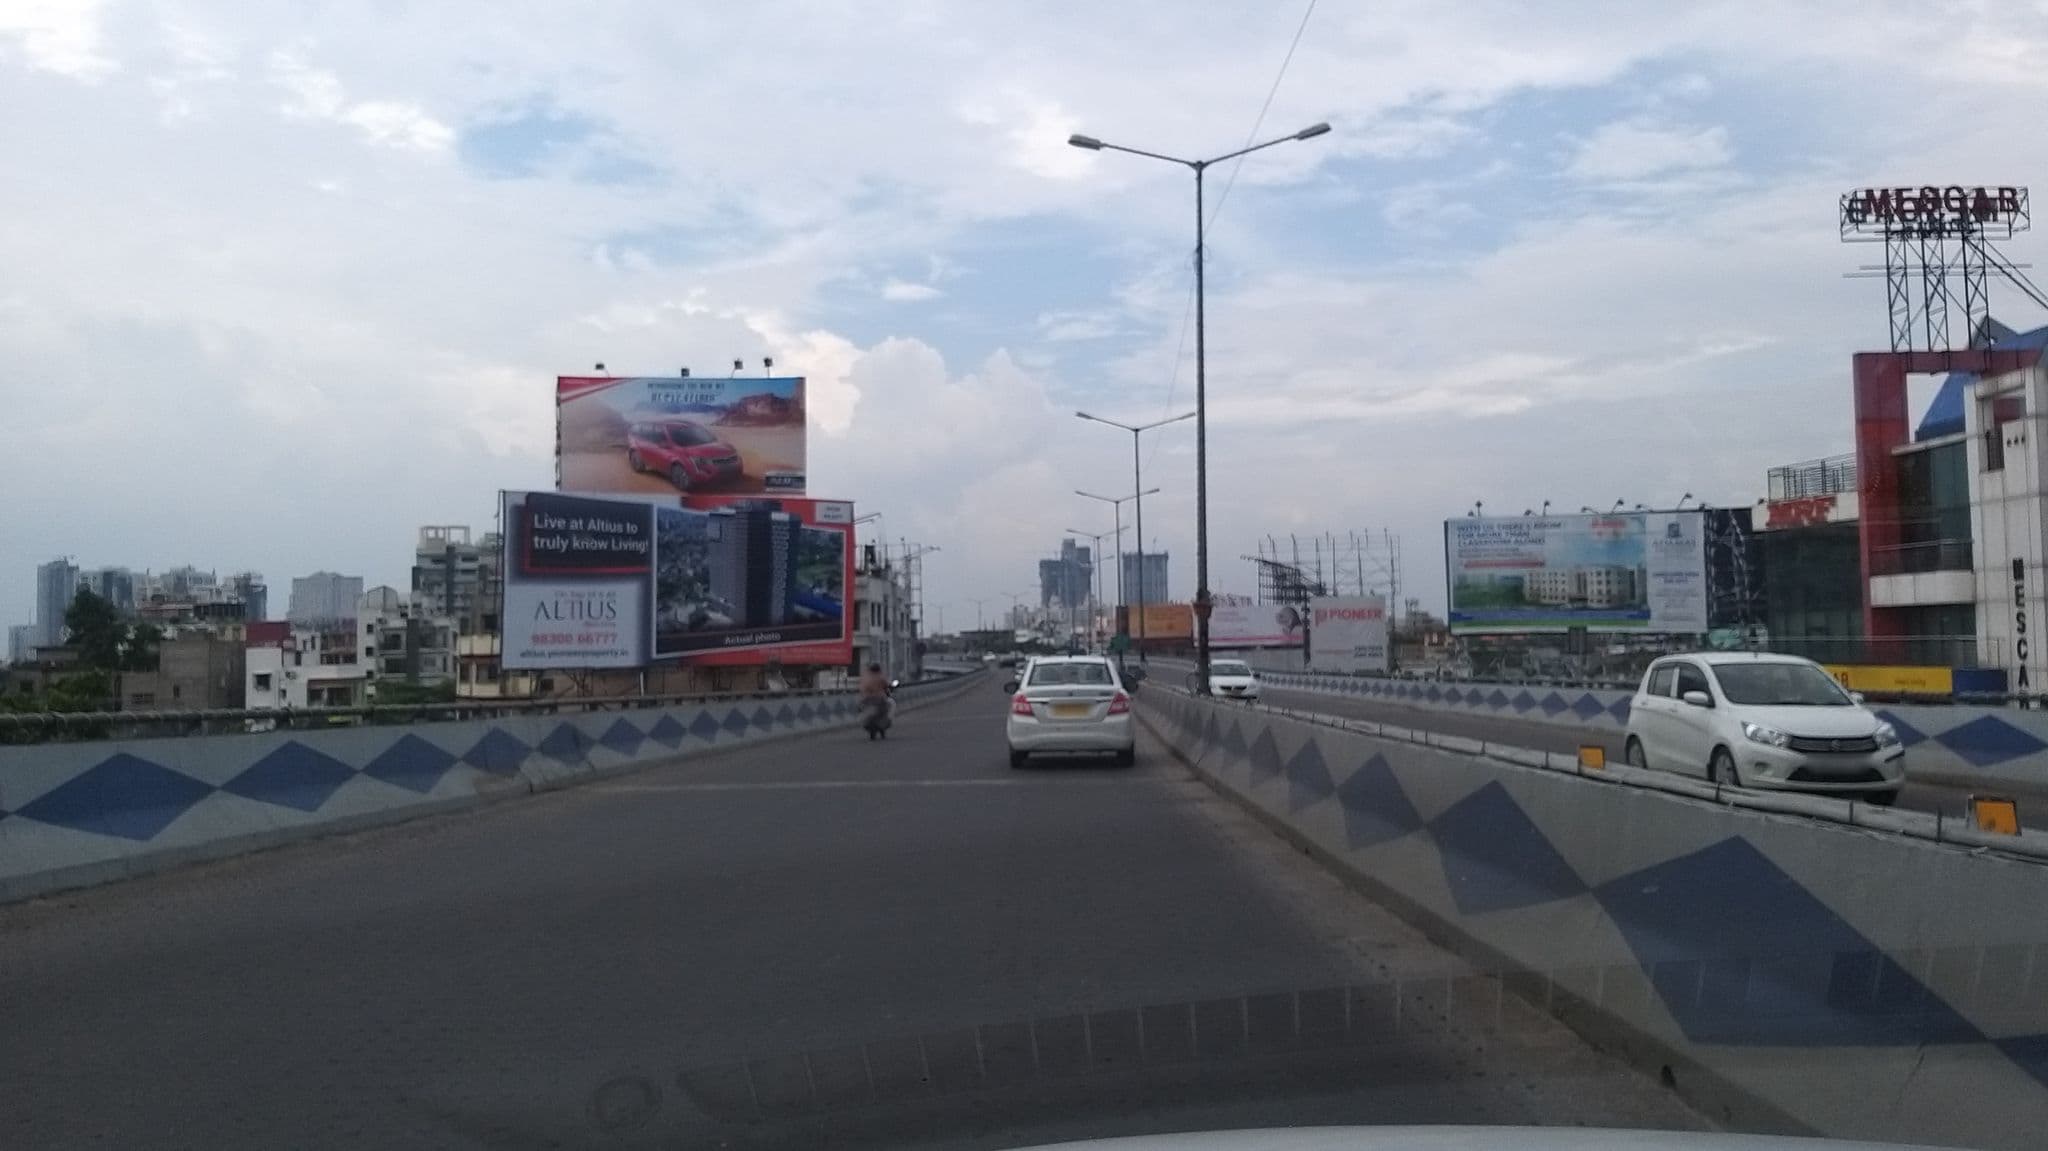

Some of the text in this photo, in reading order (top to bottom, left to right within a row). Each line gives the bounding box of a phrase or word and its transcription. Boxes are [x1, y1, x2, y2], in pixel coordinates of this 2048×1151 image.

[533, 512, 638, 534] Live at Altius to
[533, 535, 649, 554] truly know Living!
[534, 599, 617, 621] ALTIUS
[1328, 608, 1383, 620] PIONEER
[755, 632, 781, 643] photo
